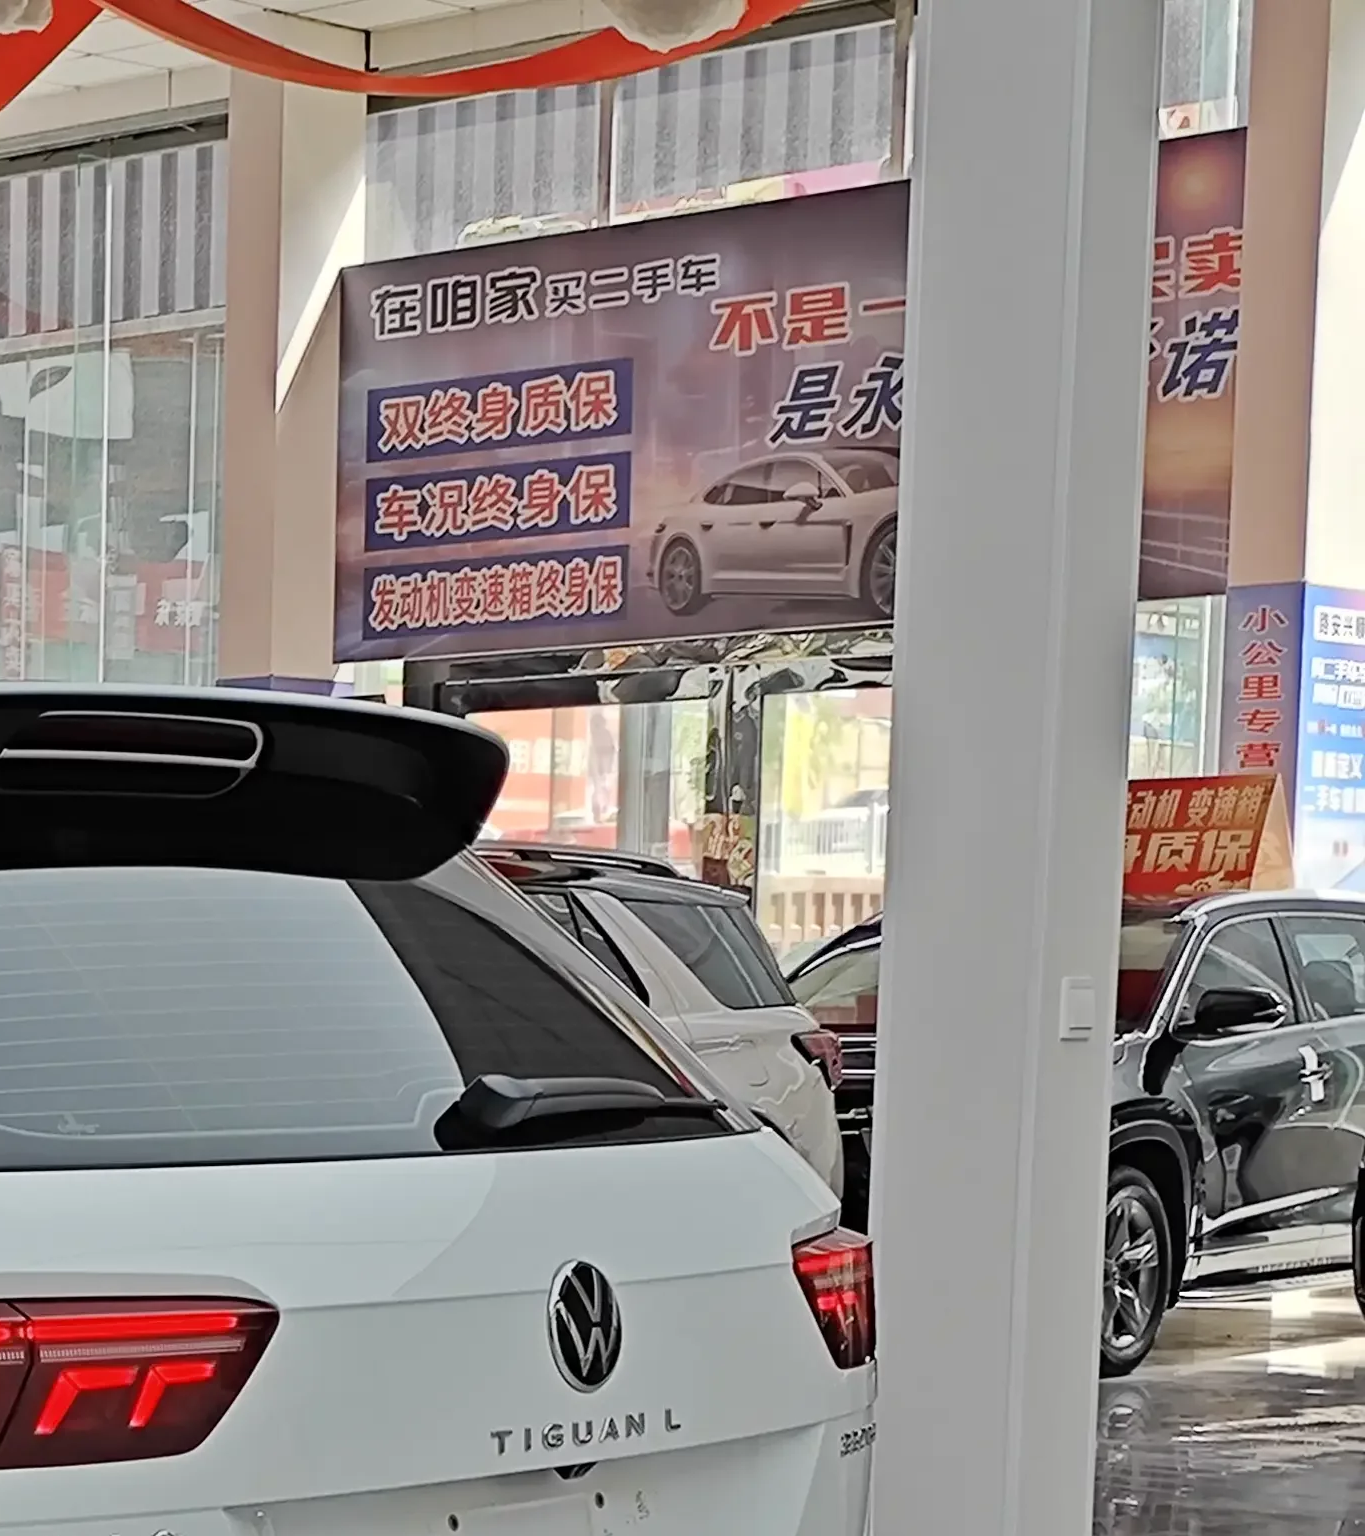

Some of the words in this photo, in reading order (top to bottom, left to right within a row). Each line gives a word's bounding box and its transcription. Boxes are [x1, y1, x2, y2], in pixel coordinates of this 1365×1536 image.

[369, 253, 721, 341] 在咱家买二手车
[709, 281, 907, 357] 不是一
[377, 368, 619, 455] 双终身质保
[766, 351, 905, 449] 是永
[1149, 306, 1240, 402] 诺
[374, 463, 618, 541] 车况终身保
[370, 554, 623, 630] 发动机变速箱终身保
[1235, 604, 1289, 770] 小公里专营
[1184, 785, 1266, 828] 变速箱
[490, 1411, 647, 1456] TIGUAN
[664, 1408, 682, 1433] L
